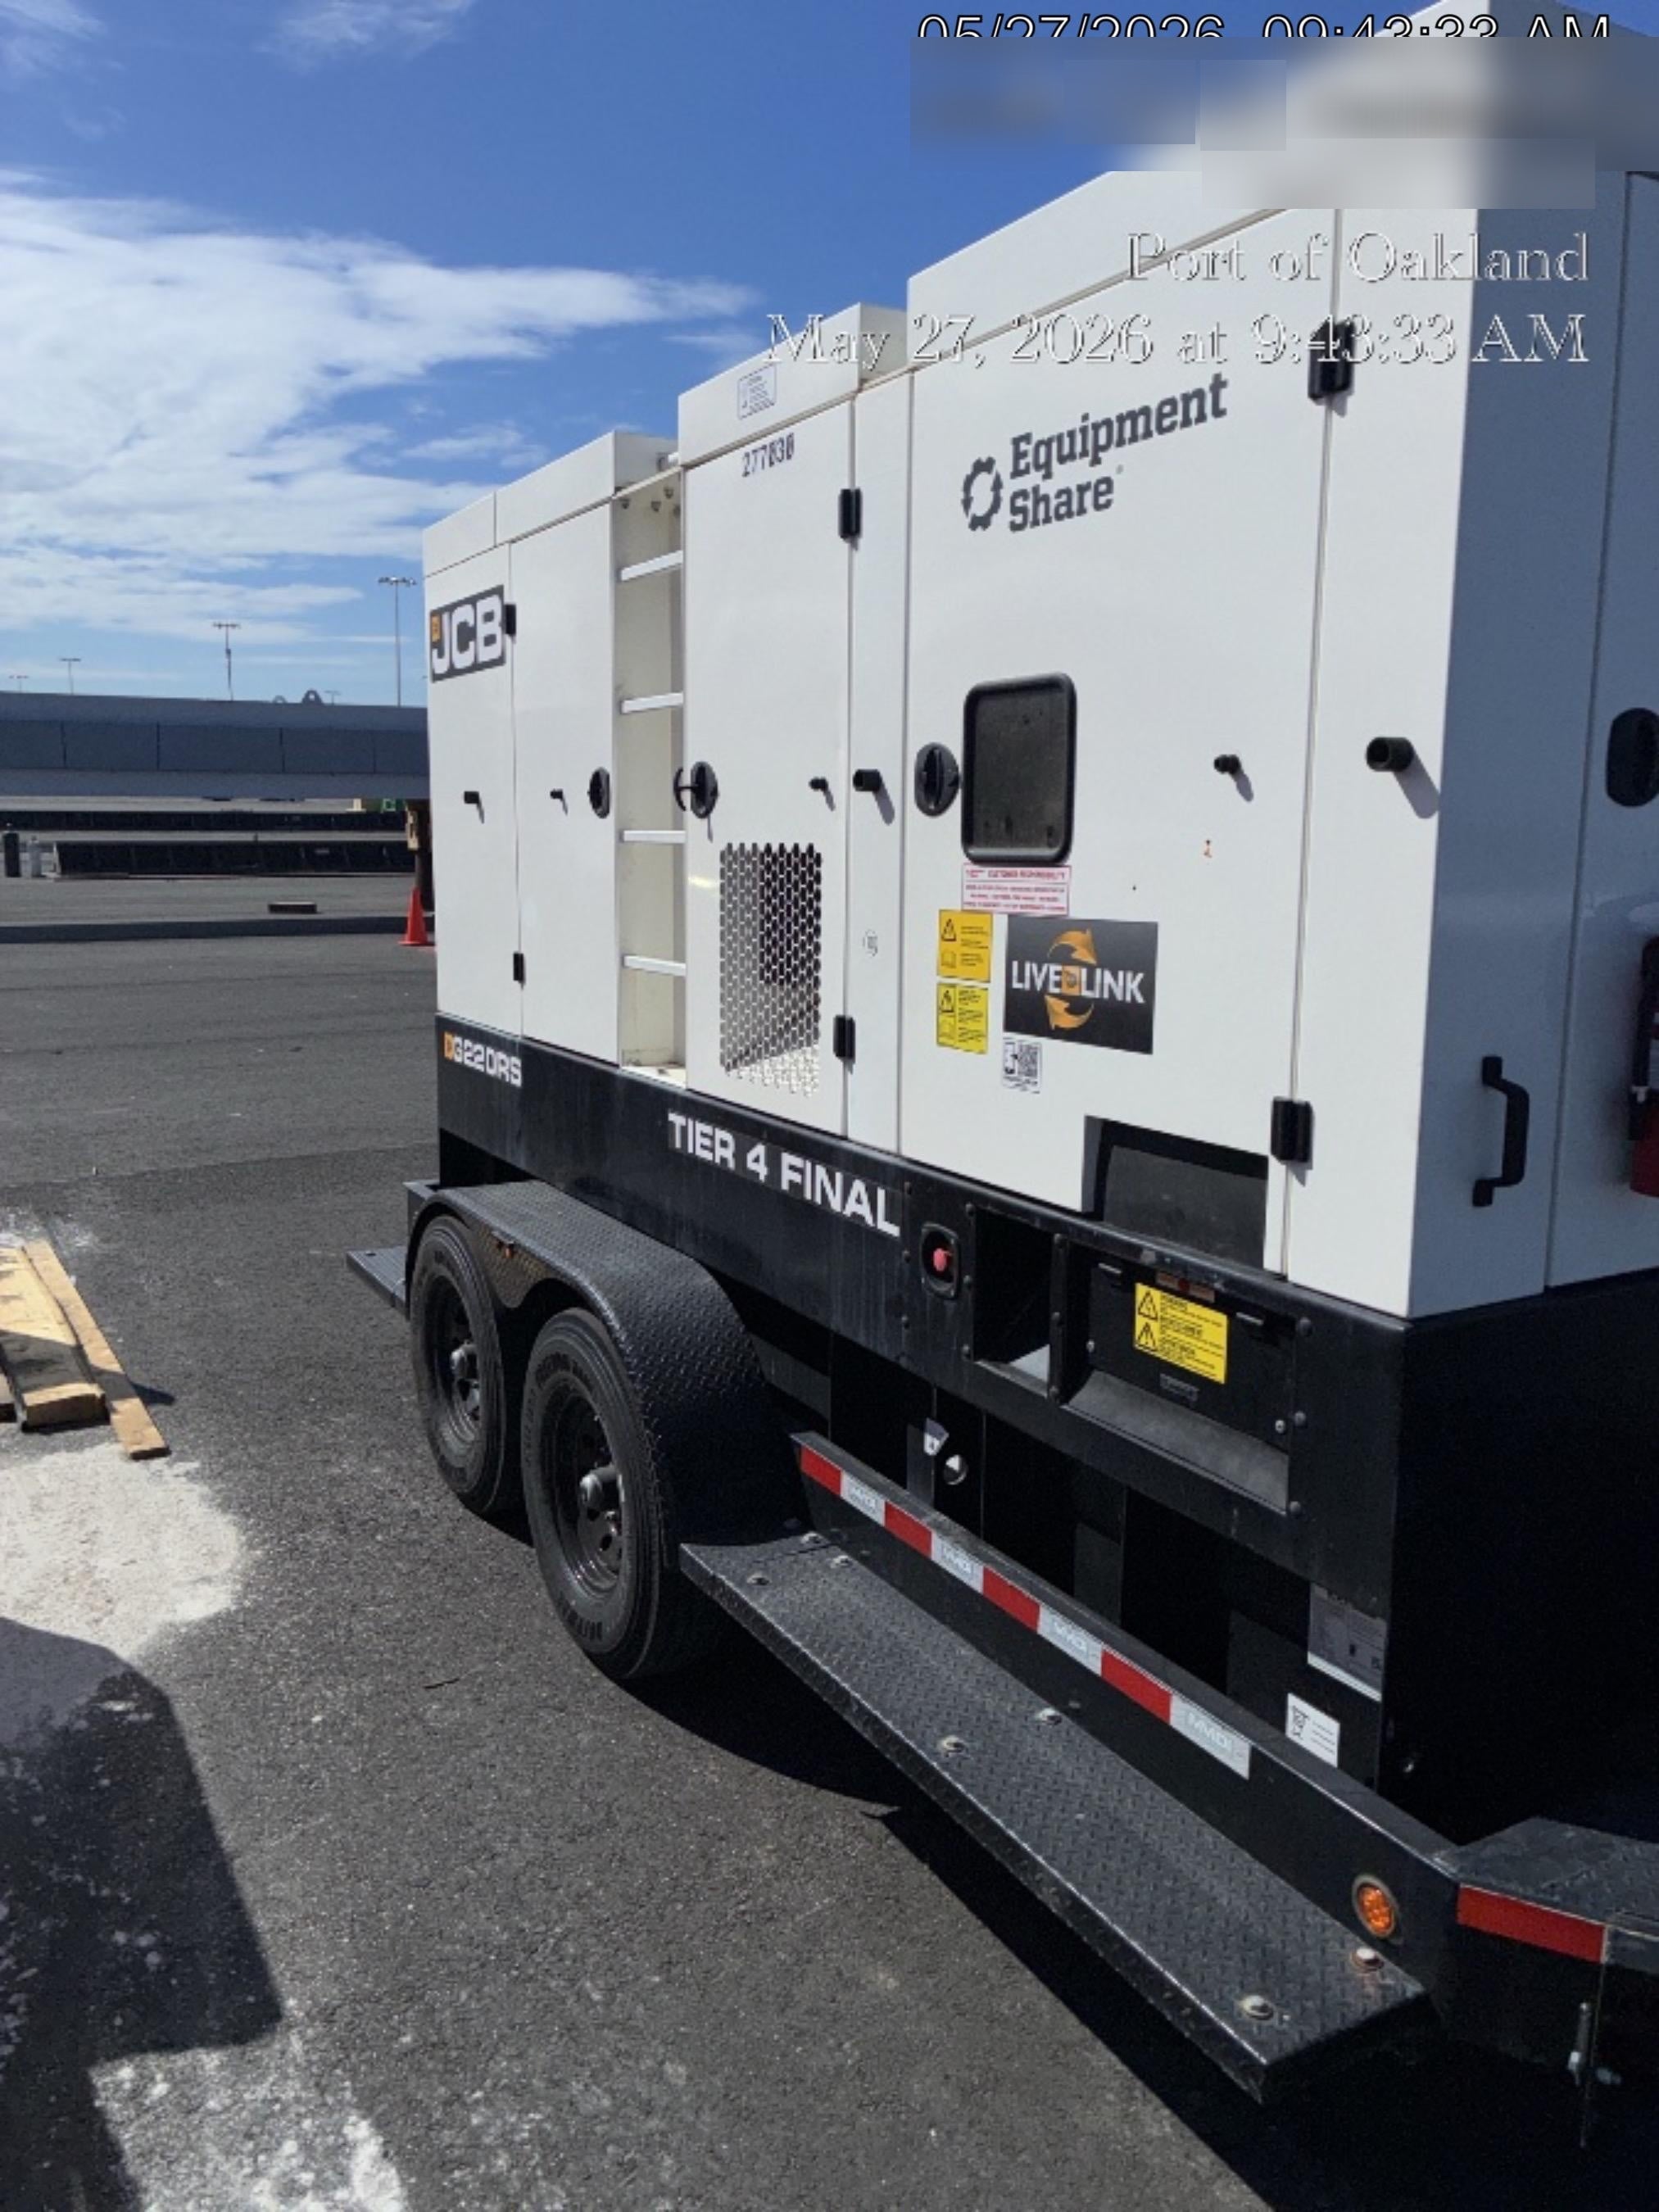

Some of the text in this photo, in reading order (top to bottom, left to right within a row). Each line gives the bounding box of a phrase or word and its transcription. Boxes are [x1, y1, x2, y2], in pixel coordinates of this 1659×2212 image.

[1009, 371, 1228, 481] Equipment
[1009, 475, 1114, 533] Share
[431, 593, 503, 674] JCB
[1011, 960, 1145, 1004] LIVE LINK
[668, 1111, 900, 1238] TIER 4 FINAL
